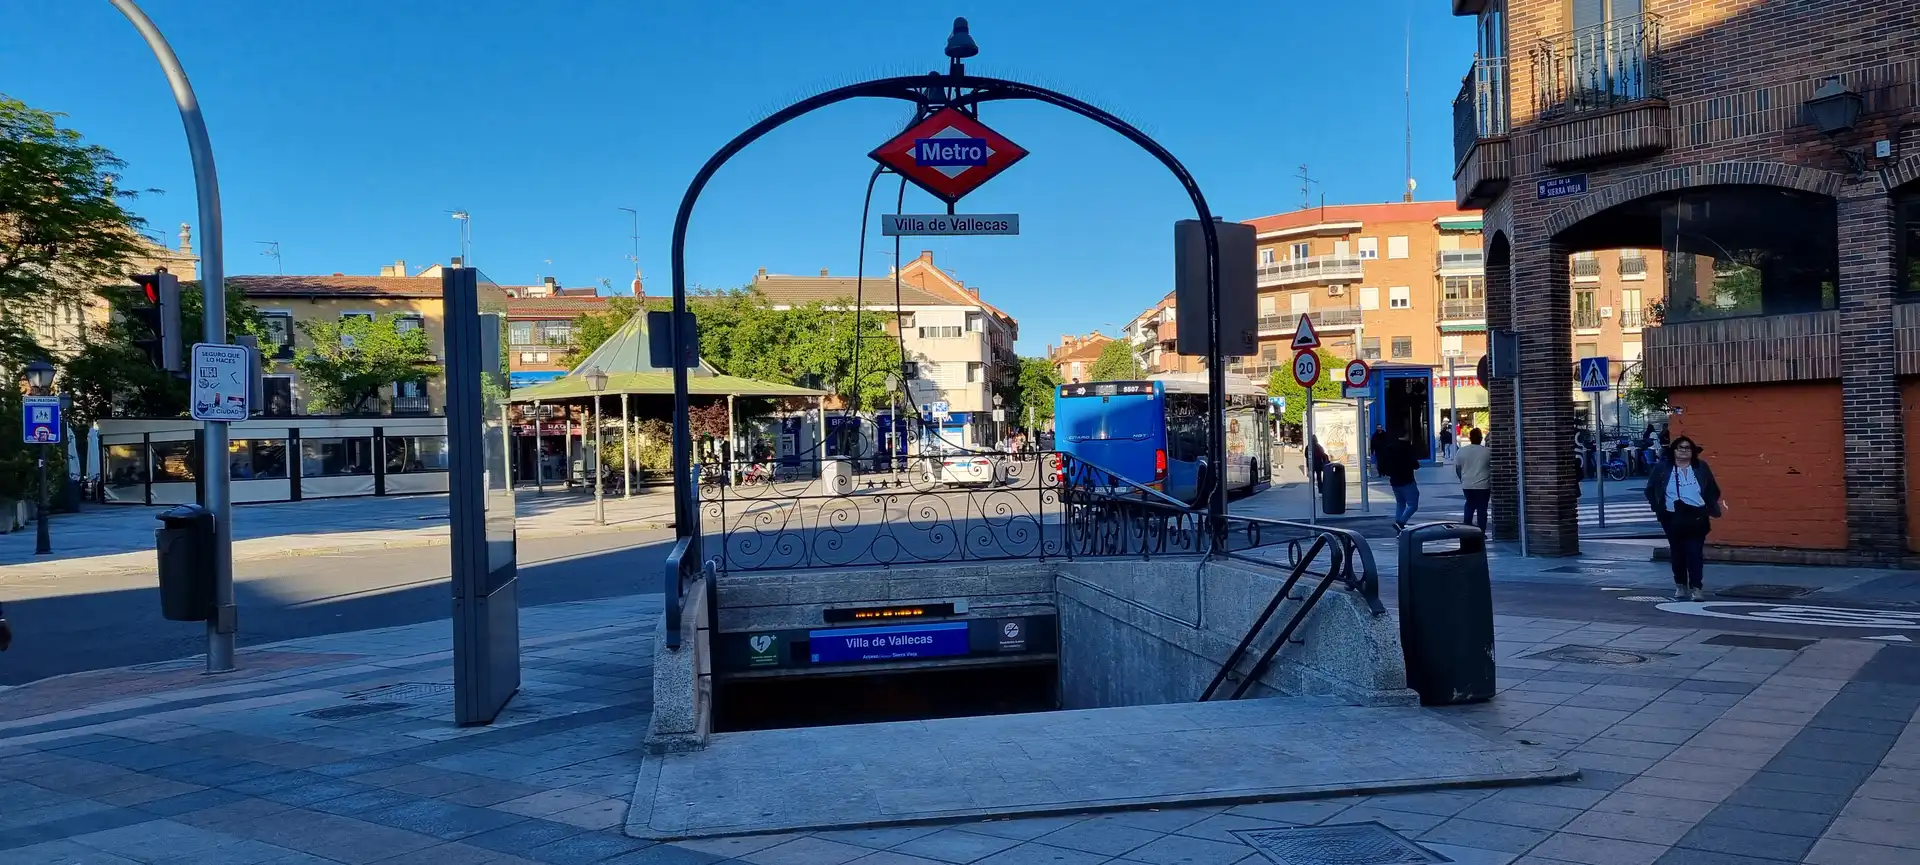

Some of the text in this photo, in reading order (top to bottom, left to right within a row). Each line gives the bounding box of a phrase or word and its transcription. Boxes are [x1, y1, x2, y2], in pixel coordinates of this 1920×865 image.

[922, 142, 982, 161] Metro
[1547, 184, 1581, 197] SIERRA VIEJA
[894, 217, 1008, 231] Villa de Vallecas
[1299, 361, 1314, 375] 20
[846, 634, 933, 648] Villa de Vallecas
